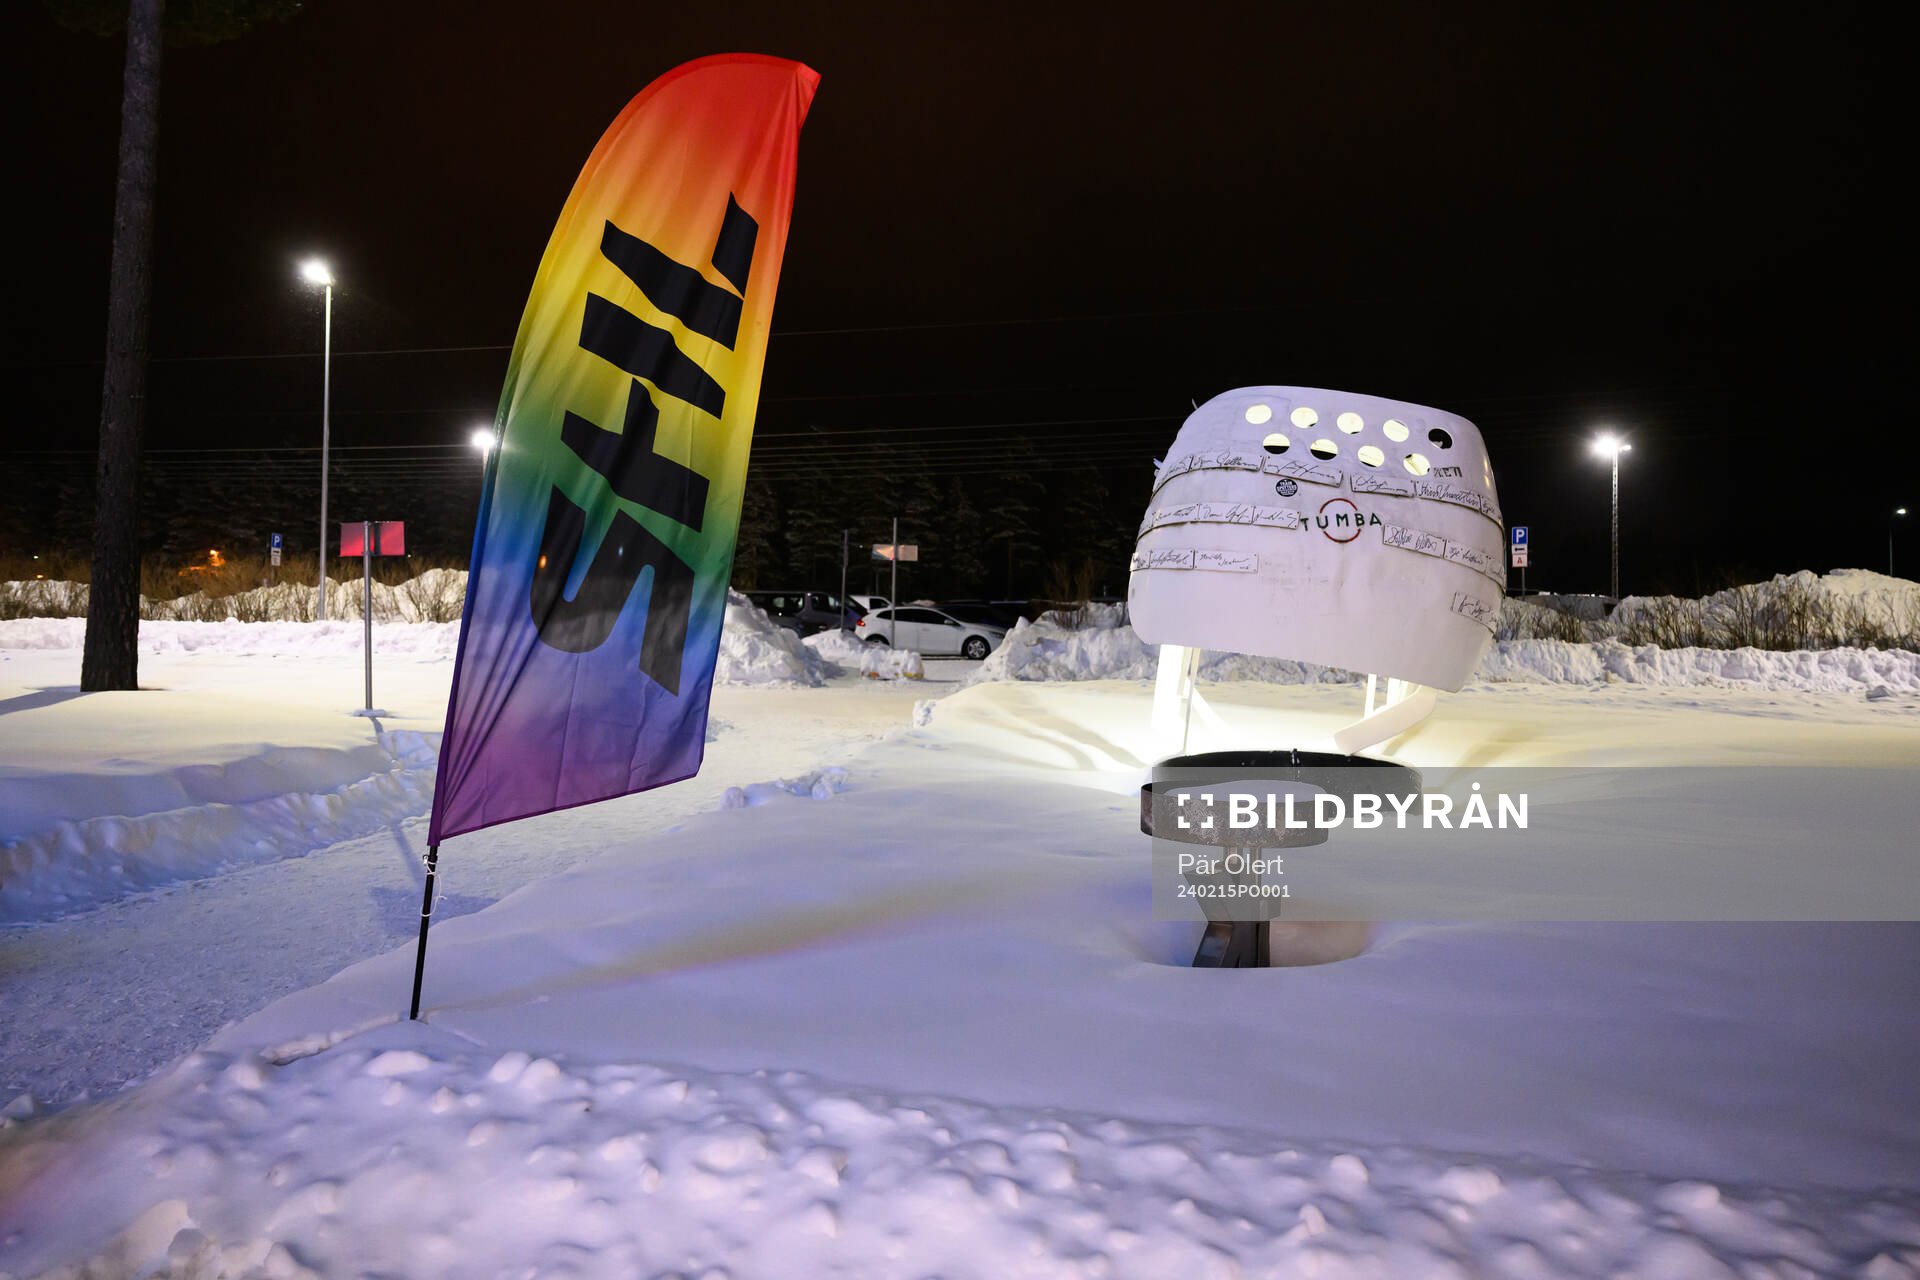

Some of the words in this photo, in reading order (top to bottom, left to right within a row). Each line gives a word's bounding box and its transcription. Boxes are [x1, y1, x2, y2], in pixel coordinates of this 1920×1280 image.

[530, 190, 759, 697] SHL
[1300, 512, 1382, 532] TUMBA
[274, 535, 280, 547] P
[1515, 529, 1525, 543] P
